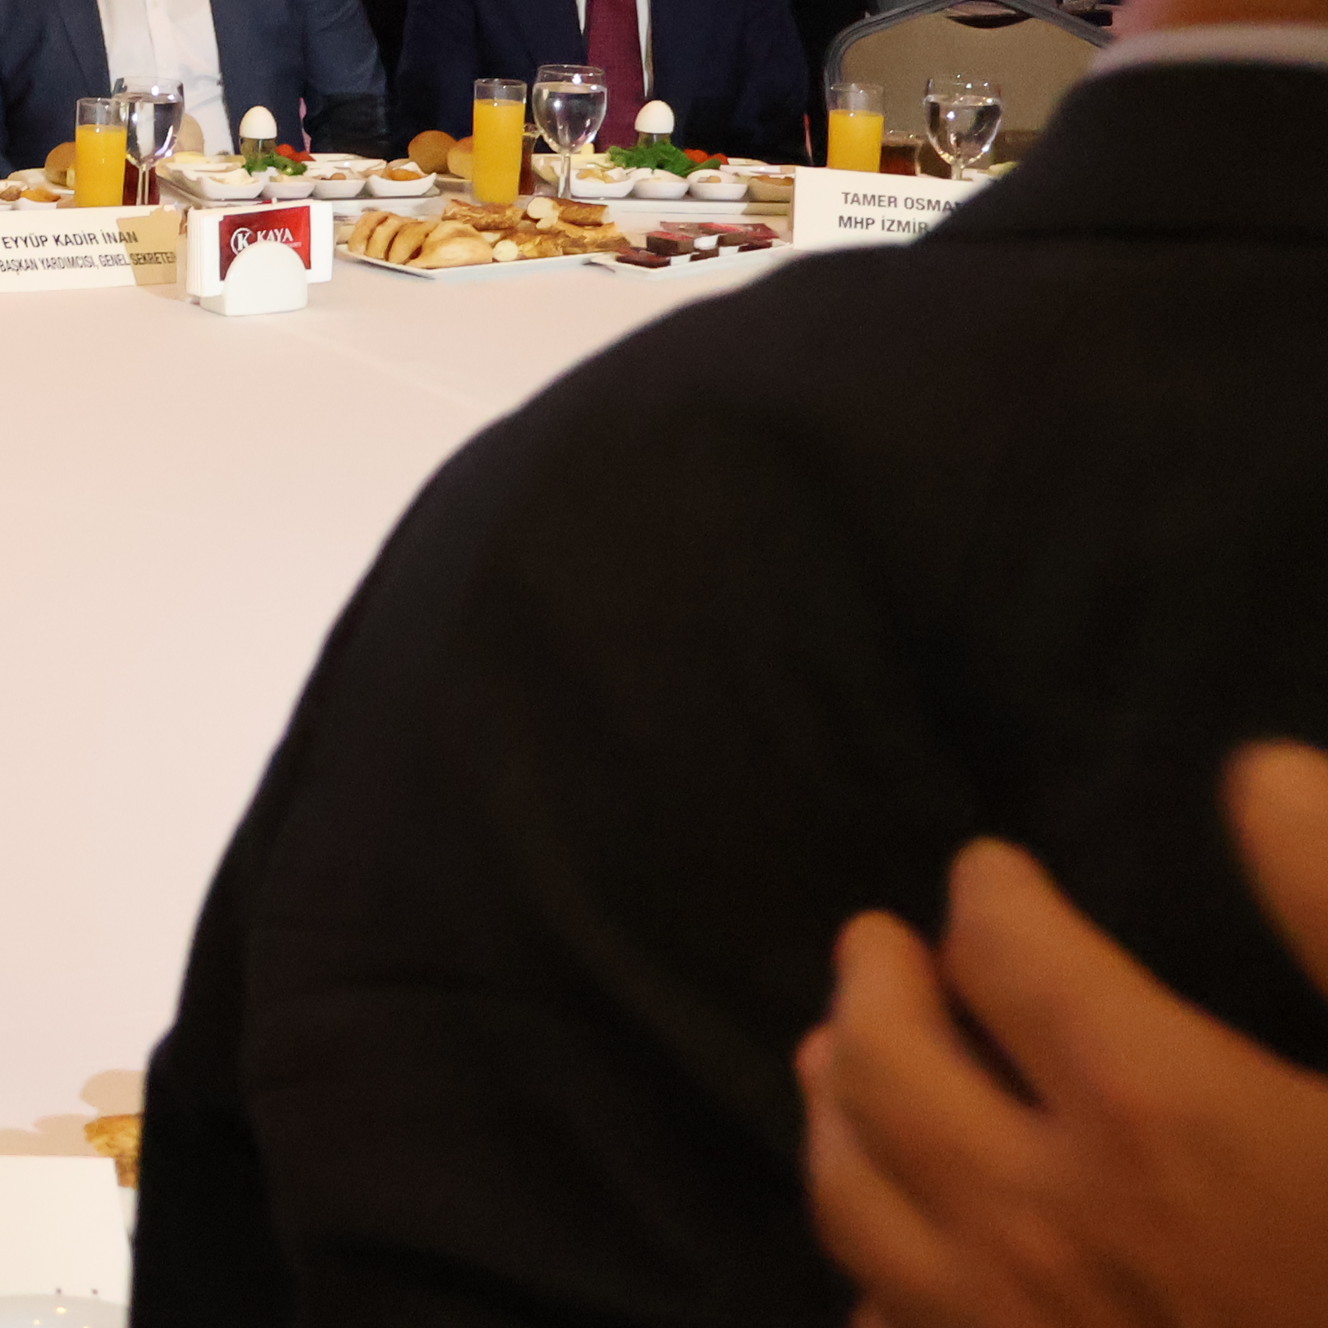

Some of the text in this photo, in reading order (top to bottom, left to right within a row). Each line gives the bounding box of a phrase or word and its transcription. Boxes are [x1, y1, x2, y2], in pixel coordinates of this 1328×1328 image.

[841, 191, 898, 209] TAMER
[837, 214, 876, 230] MHP
[52, 230, 100, 247] KADİR
[99, 229, 139, 245] İNAN
[98, 253, 131, 268] GENEL
